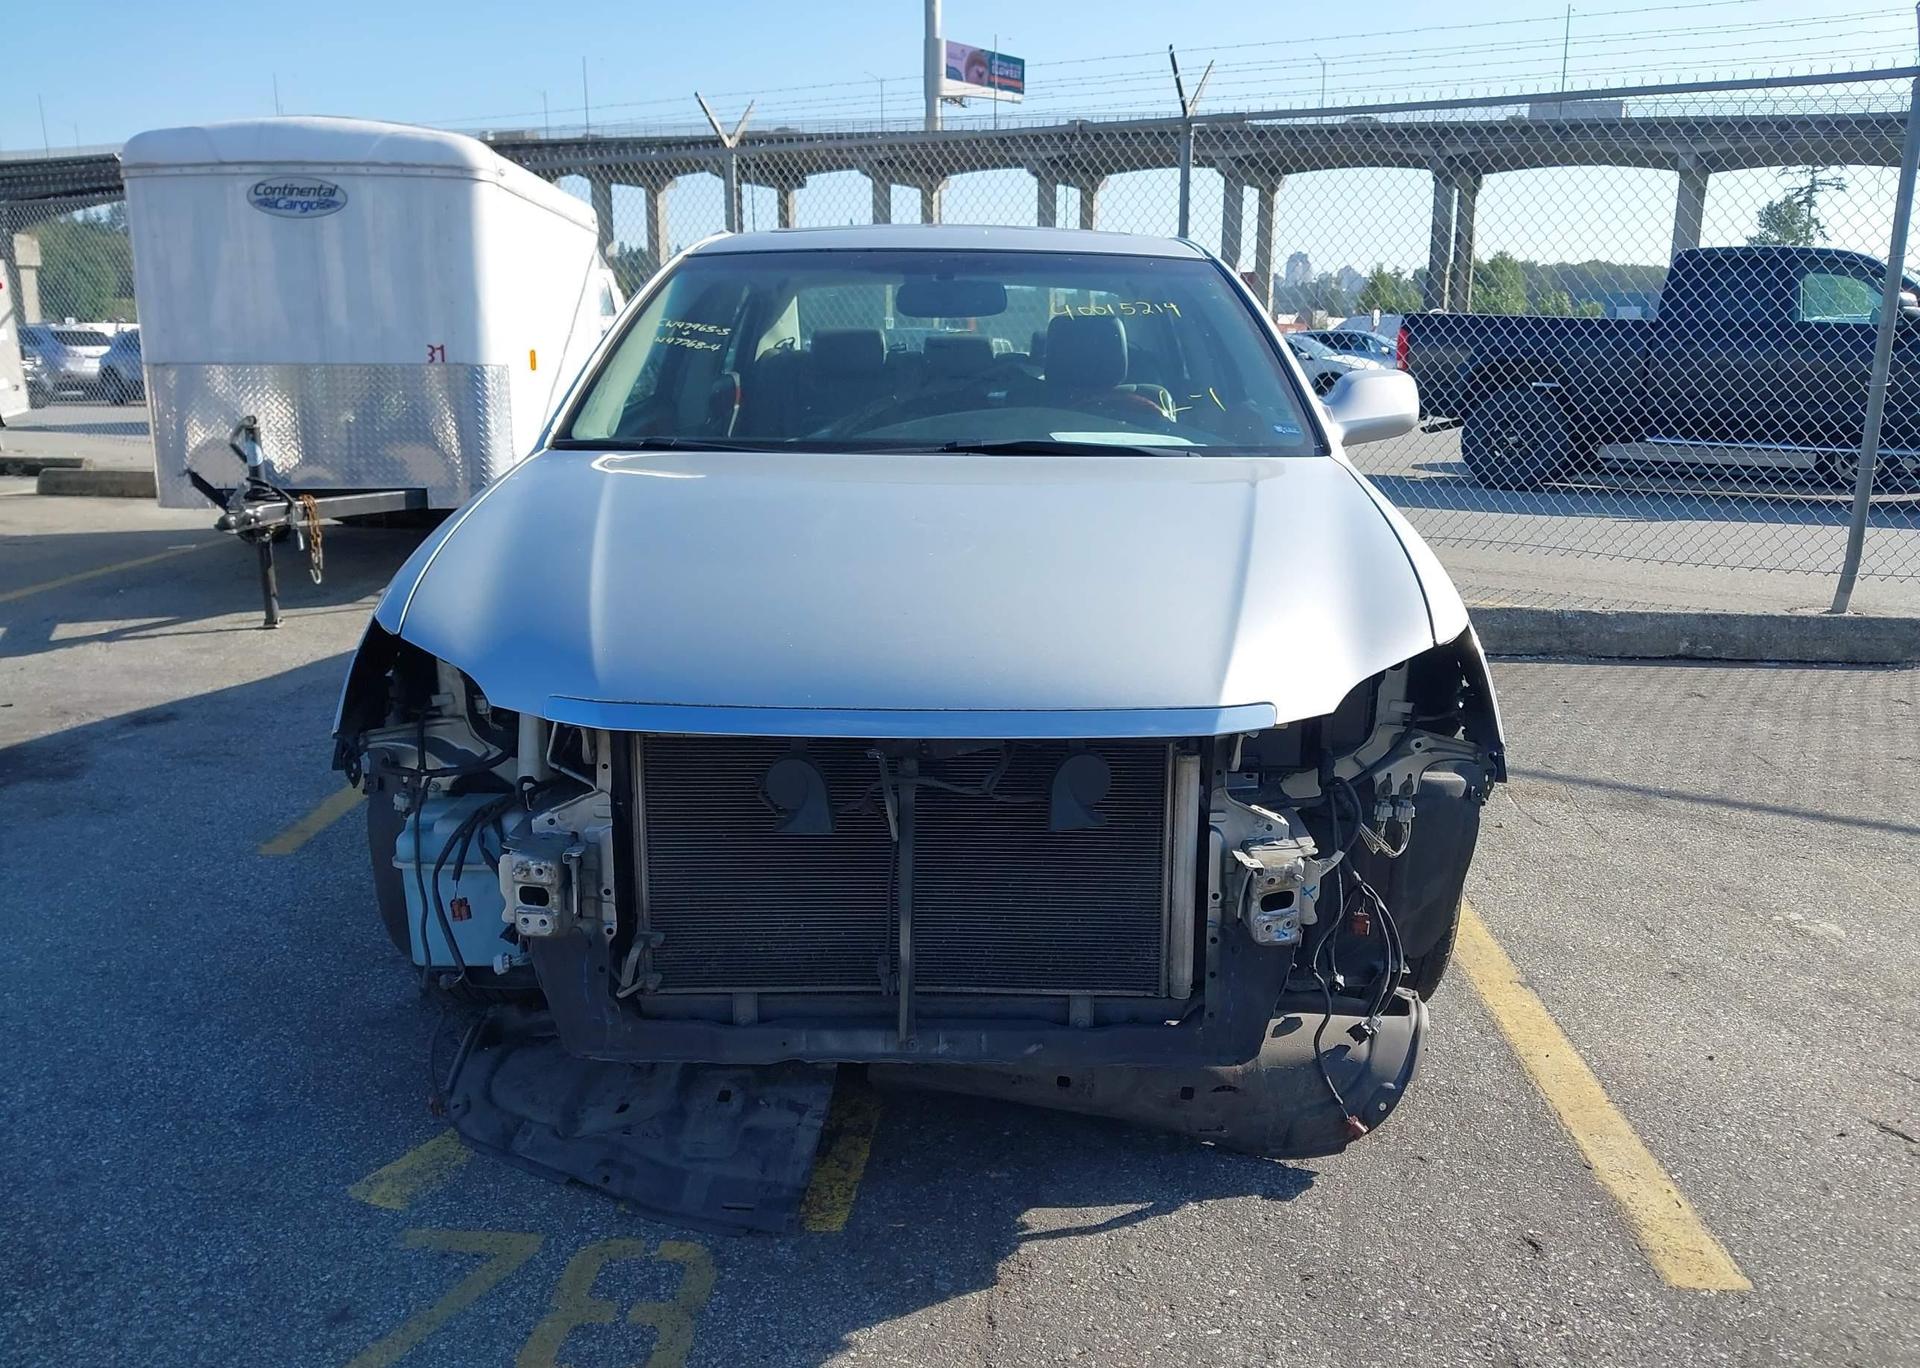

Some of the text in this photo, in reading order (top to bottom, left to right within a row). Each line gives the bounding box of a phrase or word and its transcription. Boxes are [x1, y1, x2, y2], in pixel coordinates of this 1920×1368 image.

[254, 182, 339, 198] Continental
[275, 197, 320, 213] Cargo
[1050, 301, 1182, 321] 40015214
[427, 344, 445, 363] 31
[343, 1228, 717, 1368] 78
